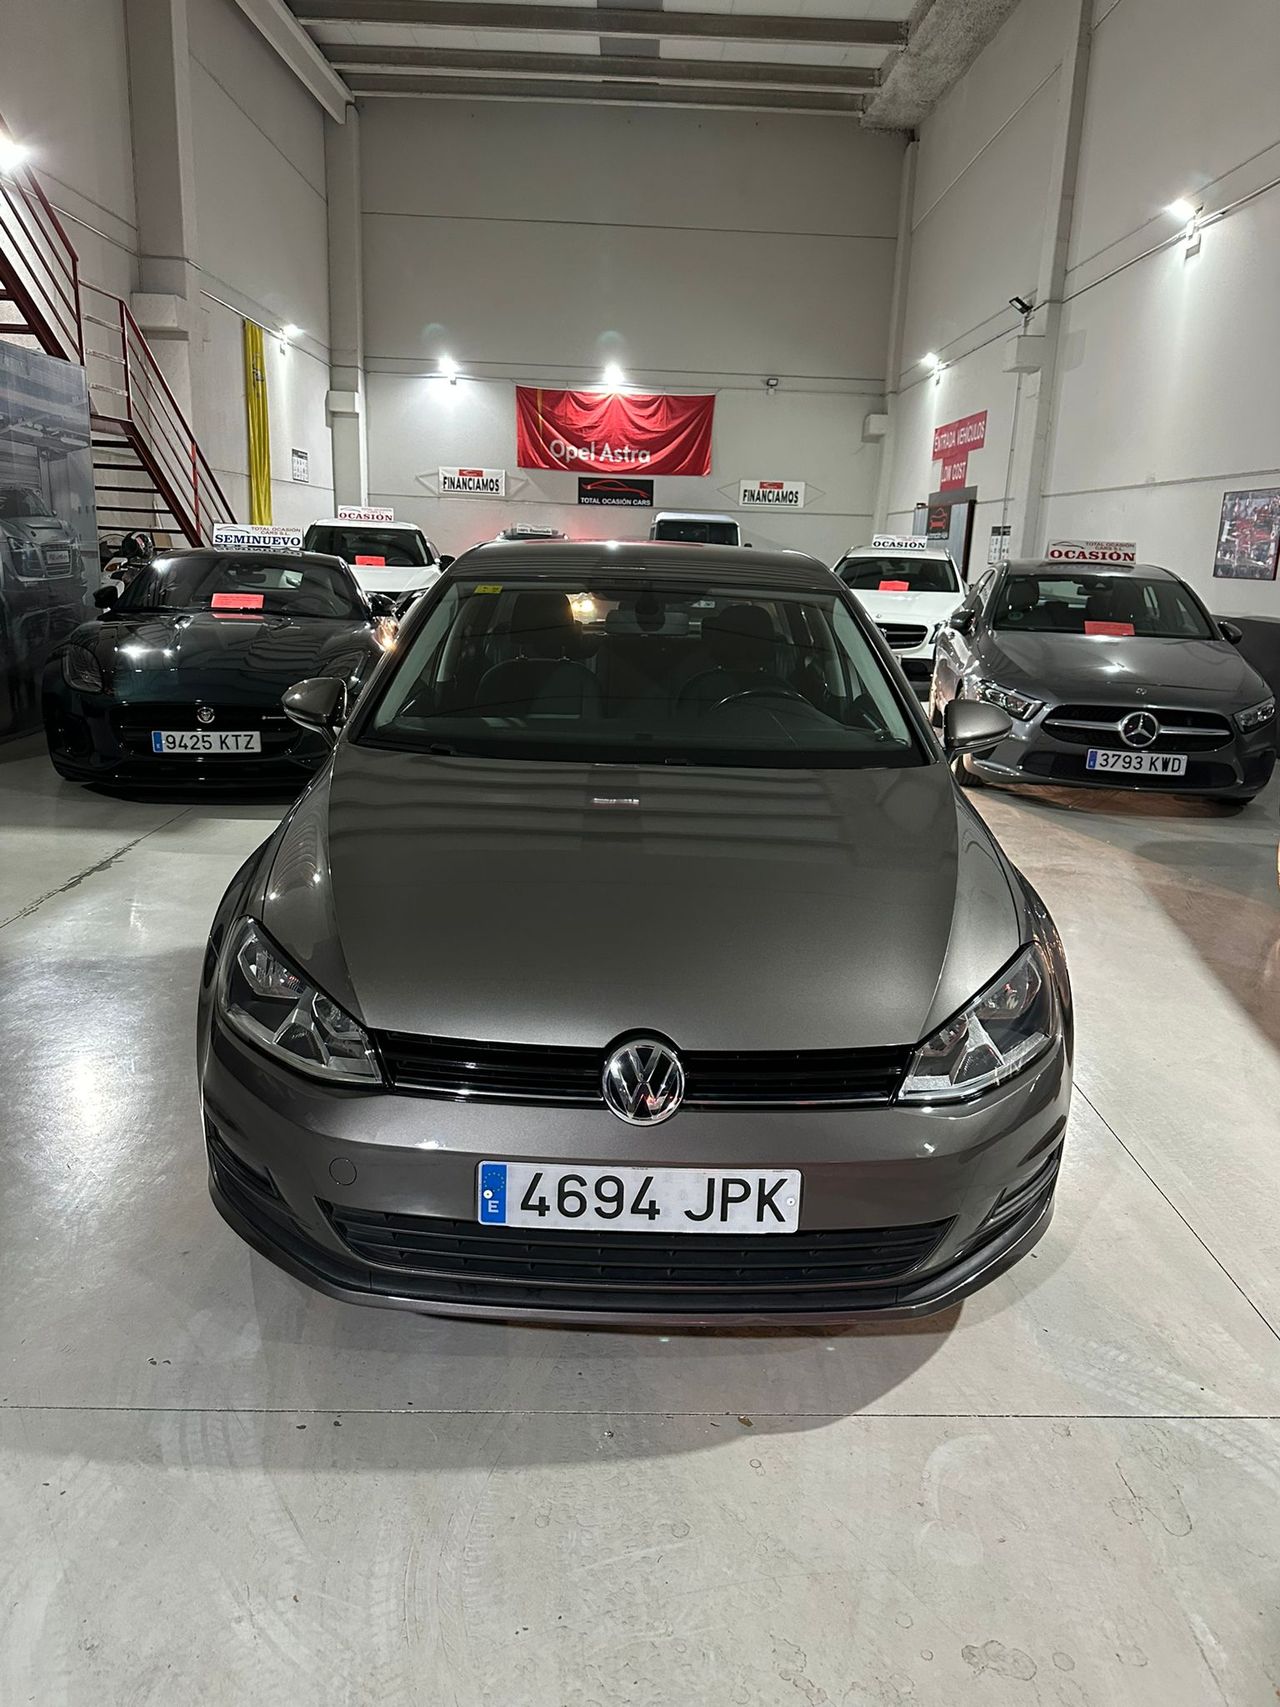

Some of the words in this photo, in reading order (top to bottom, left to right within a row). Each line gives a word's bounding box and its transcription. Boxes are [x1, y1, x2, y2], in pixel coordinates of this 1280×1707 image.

[550, 439, 595, 463] Opel
[600, 442, 651, 464] Astra
[951, 461, 966, 481] COST
[443, 476, 500, 492] FINANCIAMOS
[602, 497, 632, 505] OCASIÓN
[632, 498, 651, 506] CARS
[742, 489, 799, 504] FINANCIAMOS
[215, 534, 301, 546] SEMINUEVO
[1050, 549, 1136, 562] OCASIÓN
[165, 734, 213, 750] 9425
[219, 734, 255, 750] KTZ
[1099, 753, 1143, 771] 3793
[1148, 756, 1182, 773] KWD
[520, 1171, 661, 1221] 4694
[683, 1176, 789, 1223] JPK
[487, 1200, 499, 1213] E
